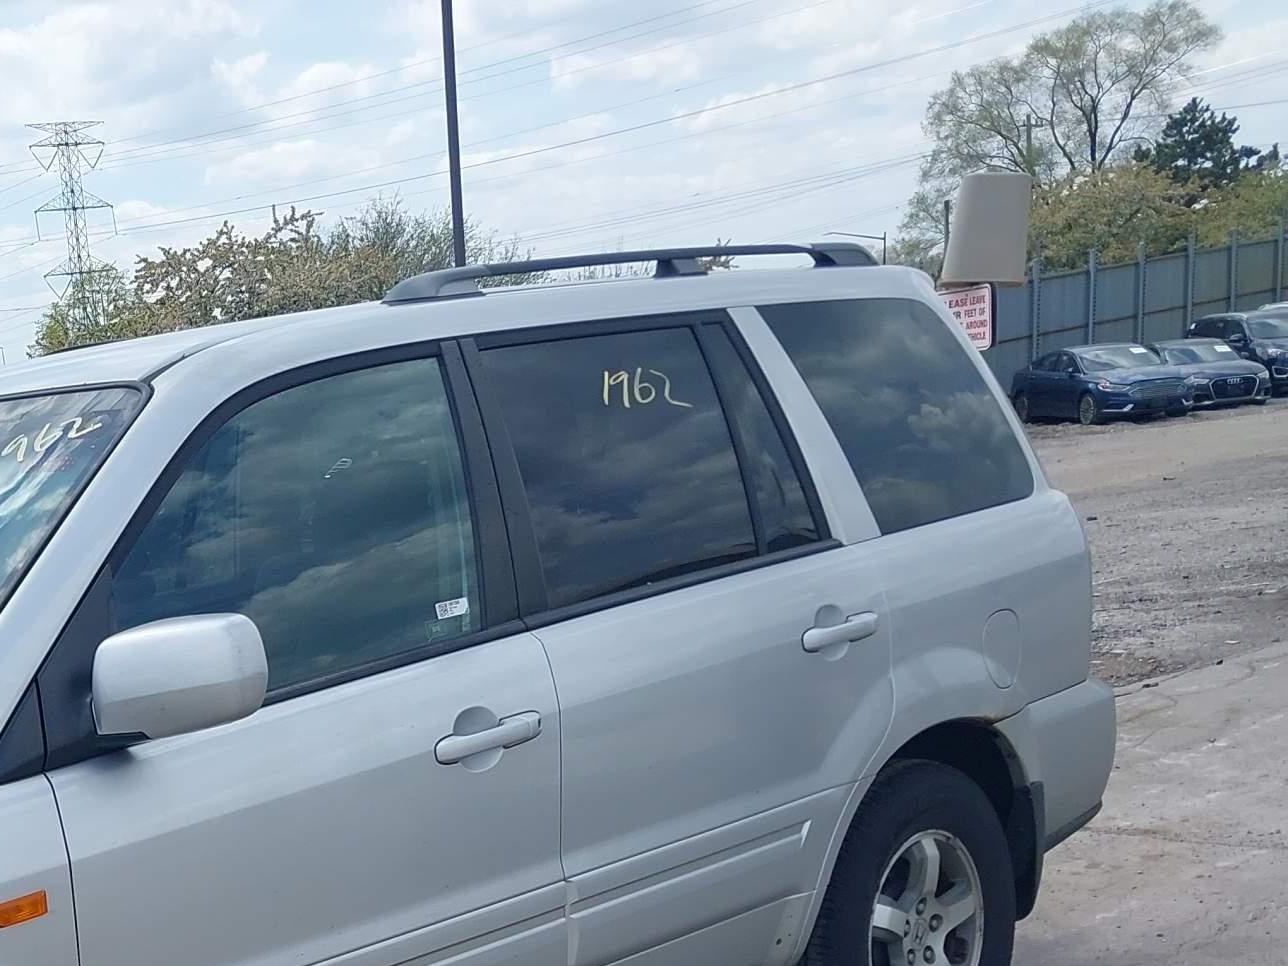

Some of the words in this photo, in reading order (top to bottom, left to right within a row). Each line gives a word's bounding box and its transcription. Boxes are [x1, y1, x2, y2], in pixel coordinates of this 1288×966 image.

[944, 298, 968, 309] EASE
[969, 295, 986, 305] LEAVE
[964, 308, 977, 318] FEET
[978, 307, 986, 315] OF
[965, 319, 987, 329] AROUND
[603, 367, 694, 409] 1962
